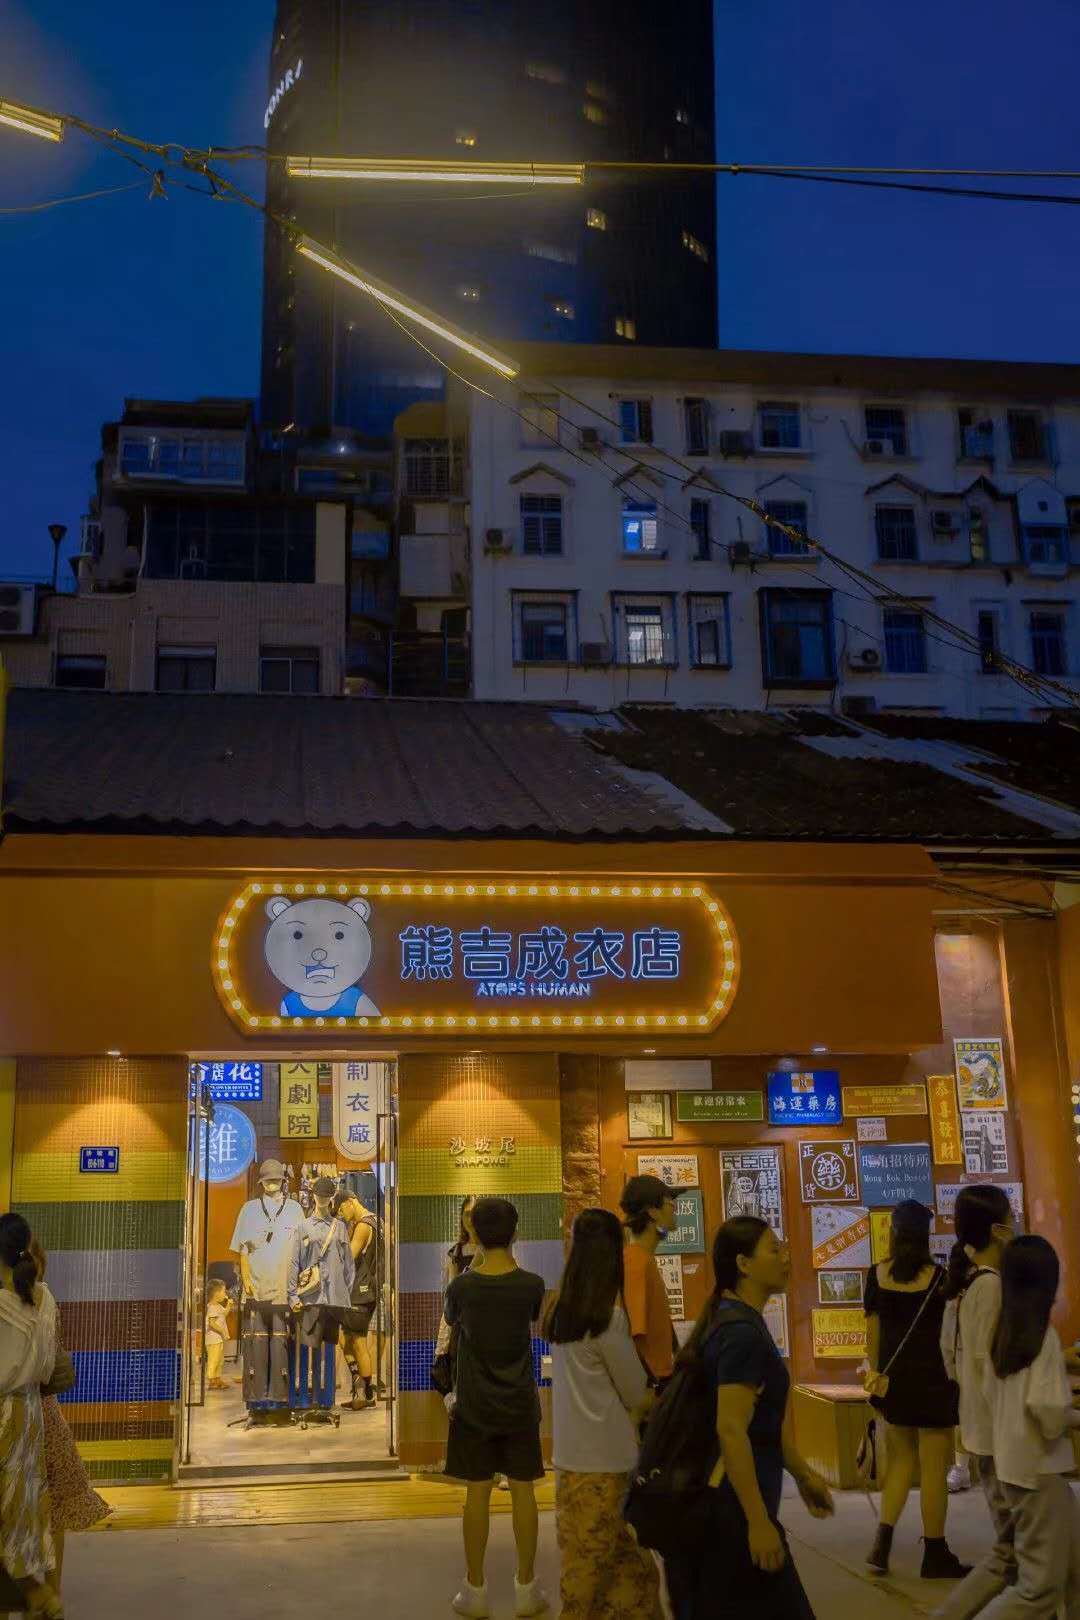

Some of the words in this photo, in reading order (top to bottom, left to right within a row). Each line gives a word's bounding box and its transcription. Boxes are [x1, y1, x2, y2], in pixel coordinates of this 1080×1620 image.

[399, 926, 681, 979] 熊吉成衣店
[530, 981, 592, 997] HUMAN
